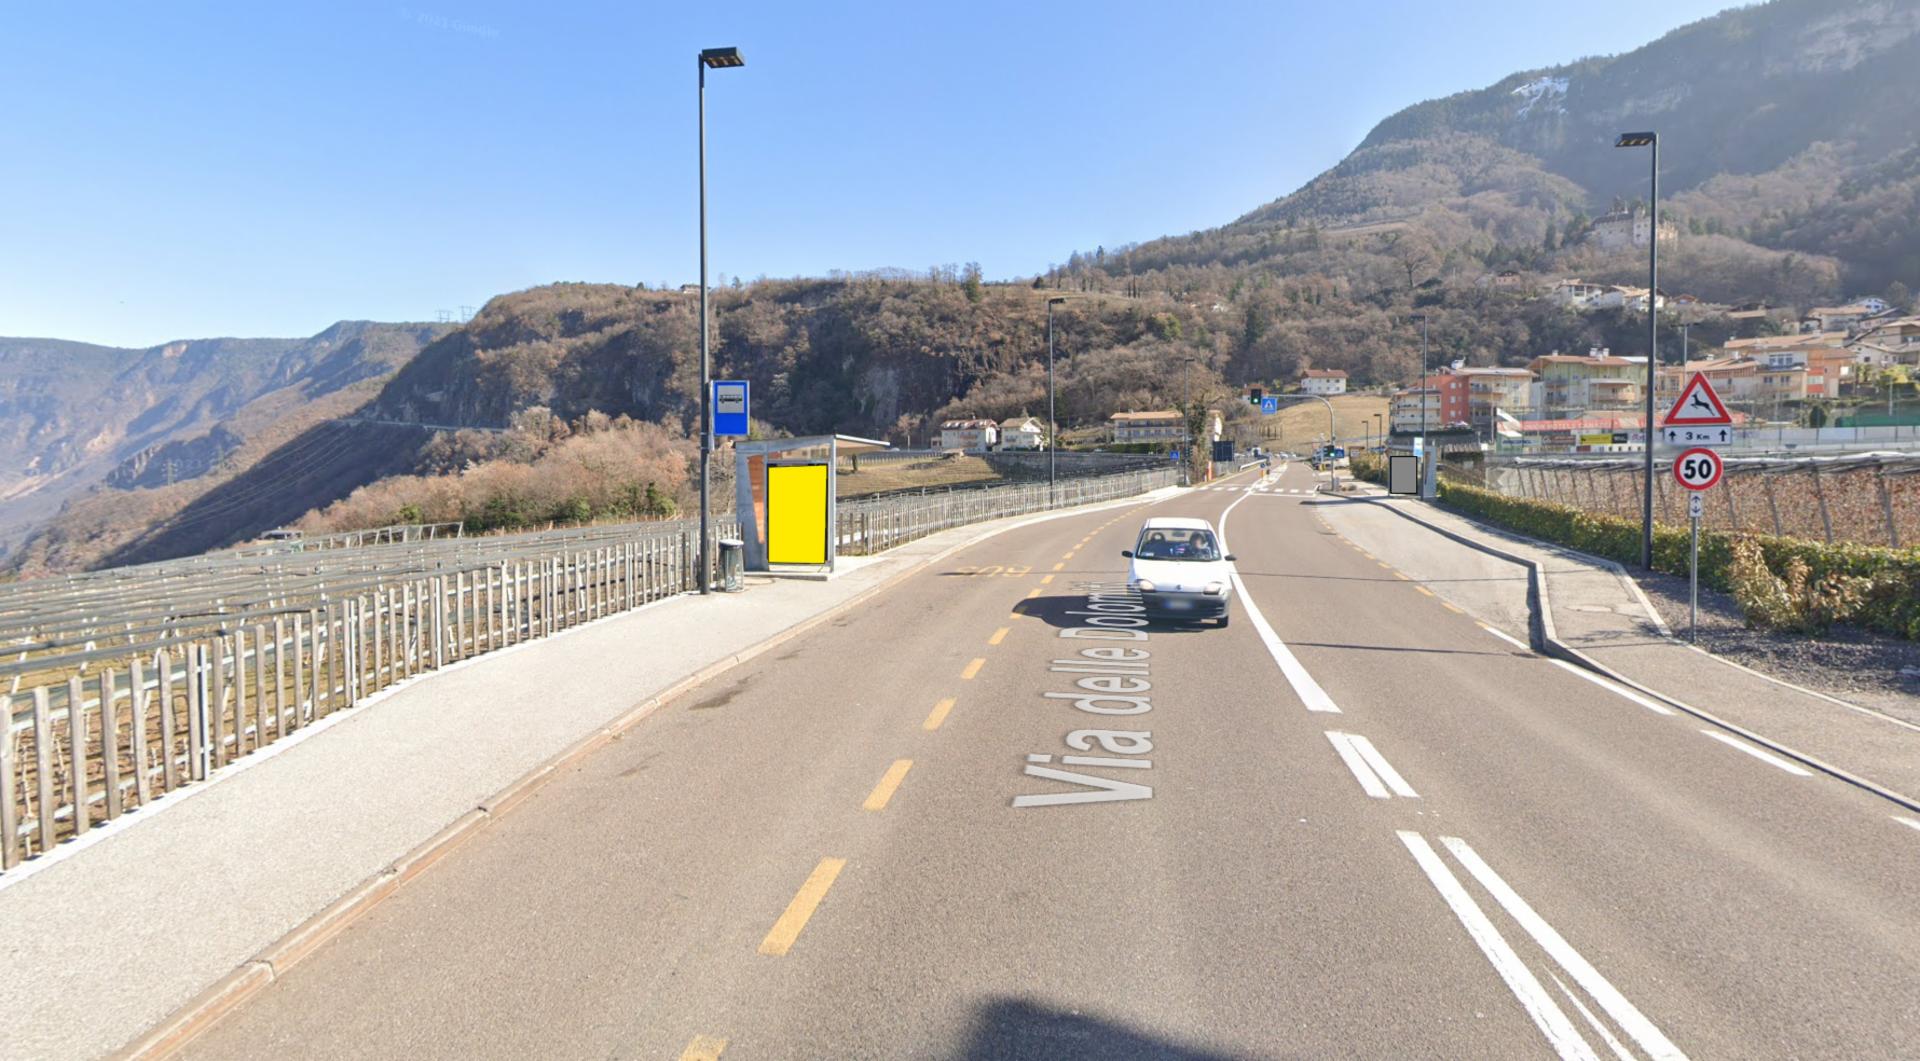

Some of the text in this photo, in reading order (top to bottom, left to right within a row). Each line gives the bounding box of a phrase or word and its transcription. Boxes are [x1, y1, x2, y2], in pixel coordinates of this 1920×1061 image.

[1685, 431, 1711, 441] 3 Km
[1683, 458, 1712, 480] 50
